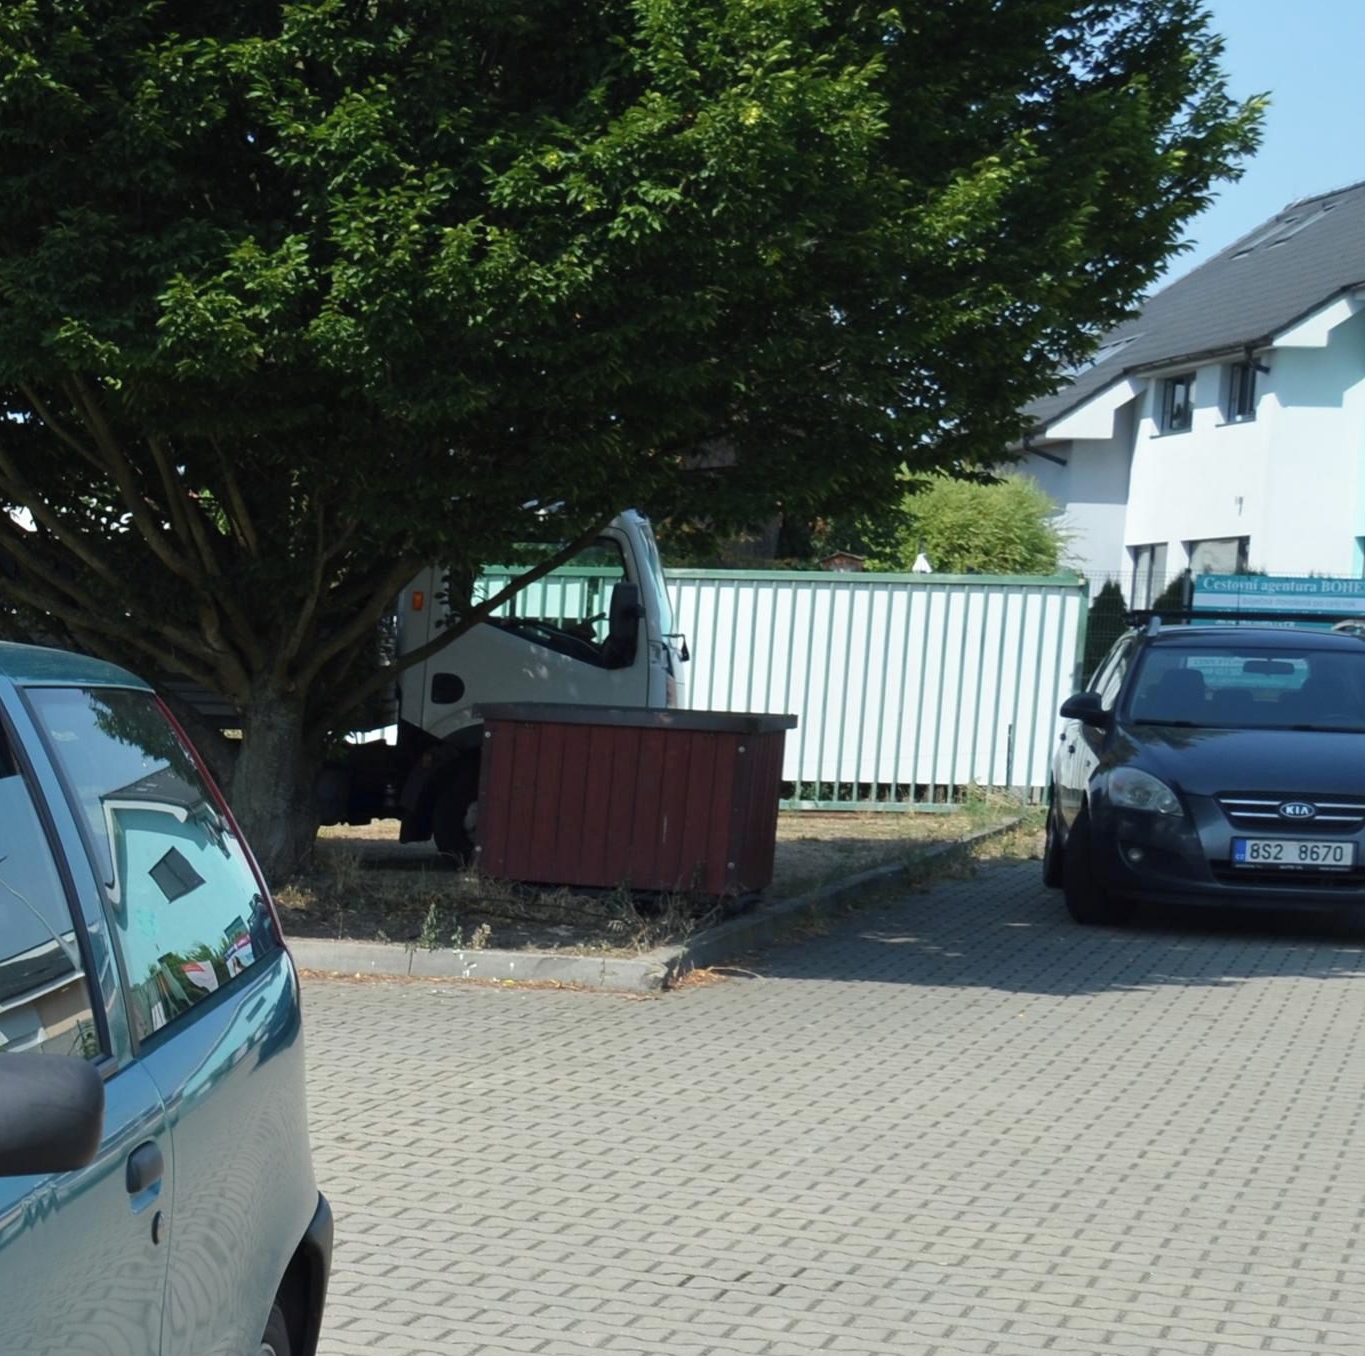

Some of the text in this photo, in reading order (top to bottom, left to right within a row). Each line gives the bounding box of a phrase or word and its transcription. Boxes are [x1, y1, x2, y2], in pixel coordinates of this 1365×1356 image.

[1203, 576, 1365, 593] Cestovní agentura BOHE
[1285, 806, 1309, 815] KIA
[1250, 843, 1284, 860] 8S2
[1298, 844, 1344, 863] 8670
